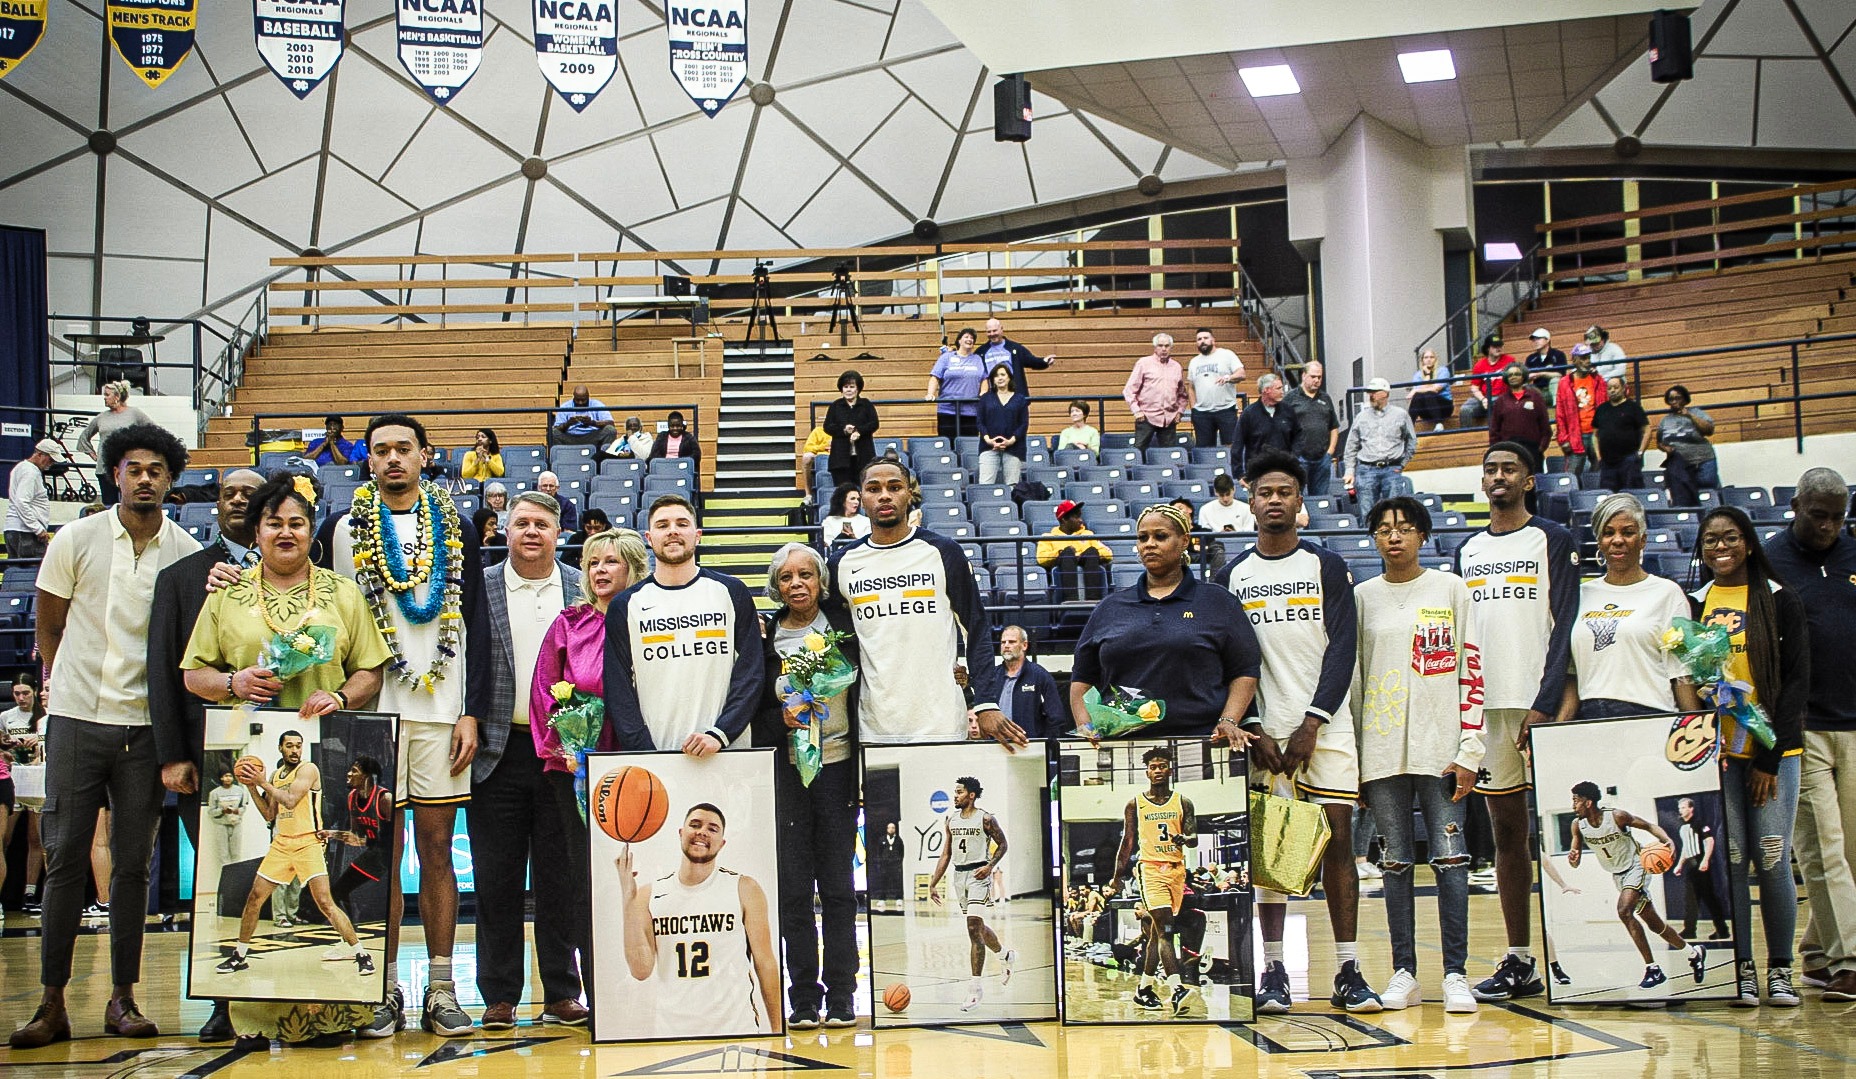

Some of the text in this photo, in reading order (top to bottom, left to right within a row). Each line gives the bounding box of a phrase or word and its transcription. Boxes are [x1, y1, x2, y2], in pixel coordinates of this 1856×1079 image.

[275, 6, 324, 15] REGIONALS
[402, 0, 478, 16] NCAA
[539, 0, 612, 23] NCAA
[112, 12, 190, 27] MEN'S TRACK
[417, 15, 463, 24] REGIONALS
[671, 6, 743, 29] NCAA
[263, 20, 336, 38] BASEBALL
[554, 23, 598, 31] REGIONALS
[686, 30, 728, 38] REGIONALS
[141, 33, 163, 43] 1975
[399, 31, 482, 45] MEN'S BASKETBALL
[552, 34, 601, 46] WOMEN'S
[141, 44, 163, 54] 1977
[286, 42, 314, 53] 2003
[547, 43, 607, 55] BASKETBALL
[692, 41, 723, 52] MEN'S
[141, 55, 164, 65] 1978
[287, 54, 314, 64] 2010
[702, 50, 745, 62] COUNTRY
[287, 65, 314, 75] 2018
[559, 62, 595, 74] 2009
[1463, 560, 1539, 580] MISSISSIPPI
[848, 573, 935, 595] MISSISSIPPI
[1235, 581, 1320, 600] MISSISSIPPI
[856, 600, 937, 621] COLLEGE
[639, 612, 726, 633] MISSISSIPPI
[643, 641, 728, 661] COLLEGE
[1425, 655, 1456, 671] Coca-Cola
[598, 771, 620, 823] Wilson
[1144, 811, 1178, 821] MISSISSIPPI
[1157, 823, 1169, 842] 3
[958, 838, 967, 854] 4
[1601, 847, 1612, 858] 1
[652, 913, 735, 936] CHOCTAWS
[675, 941, 710, 978] 12
